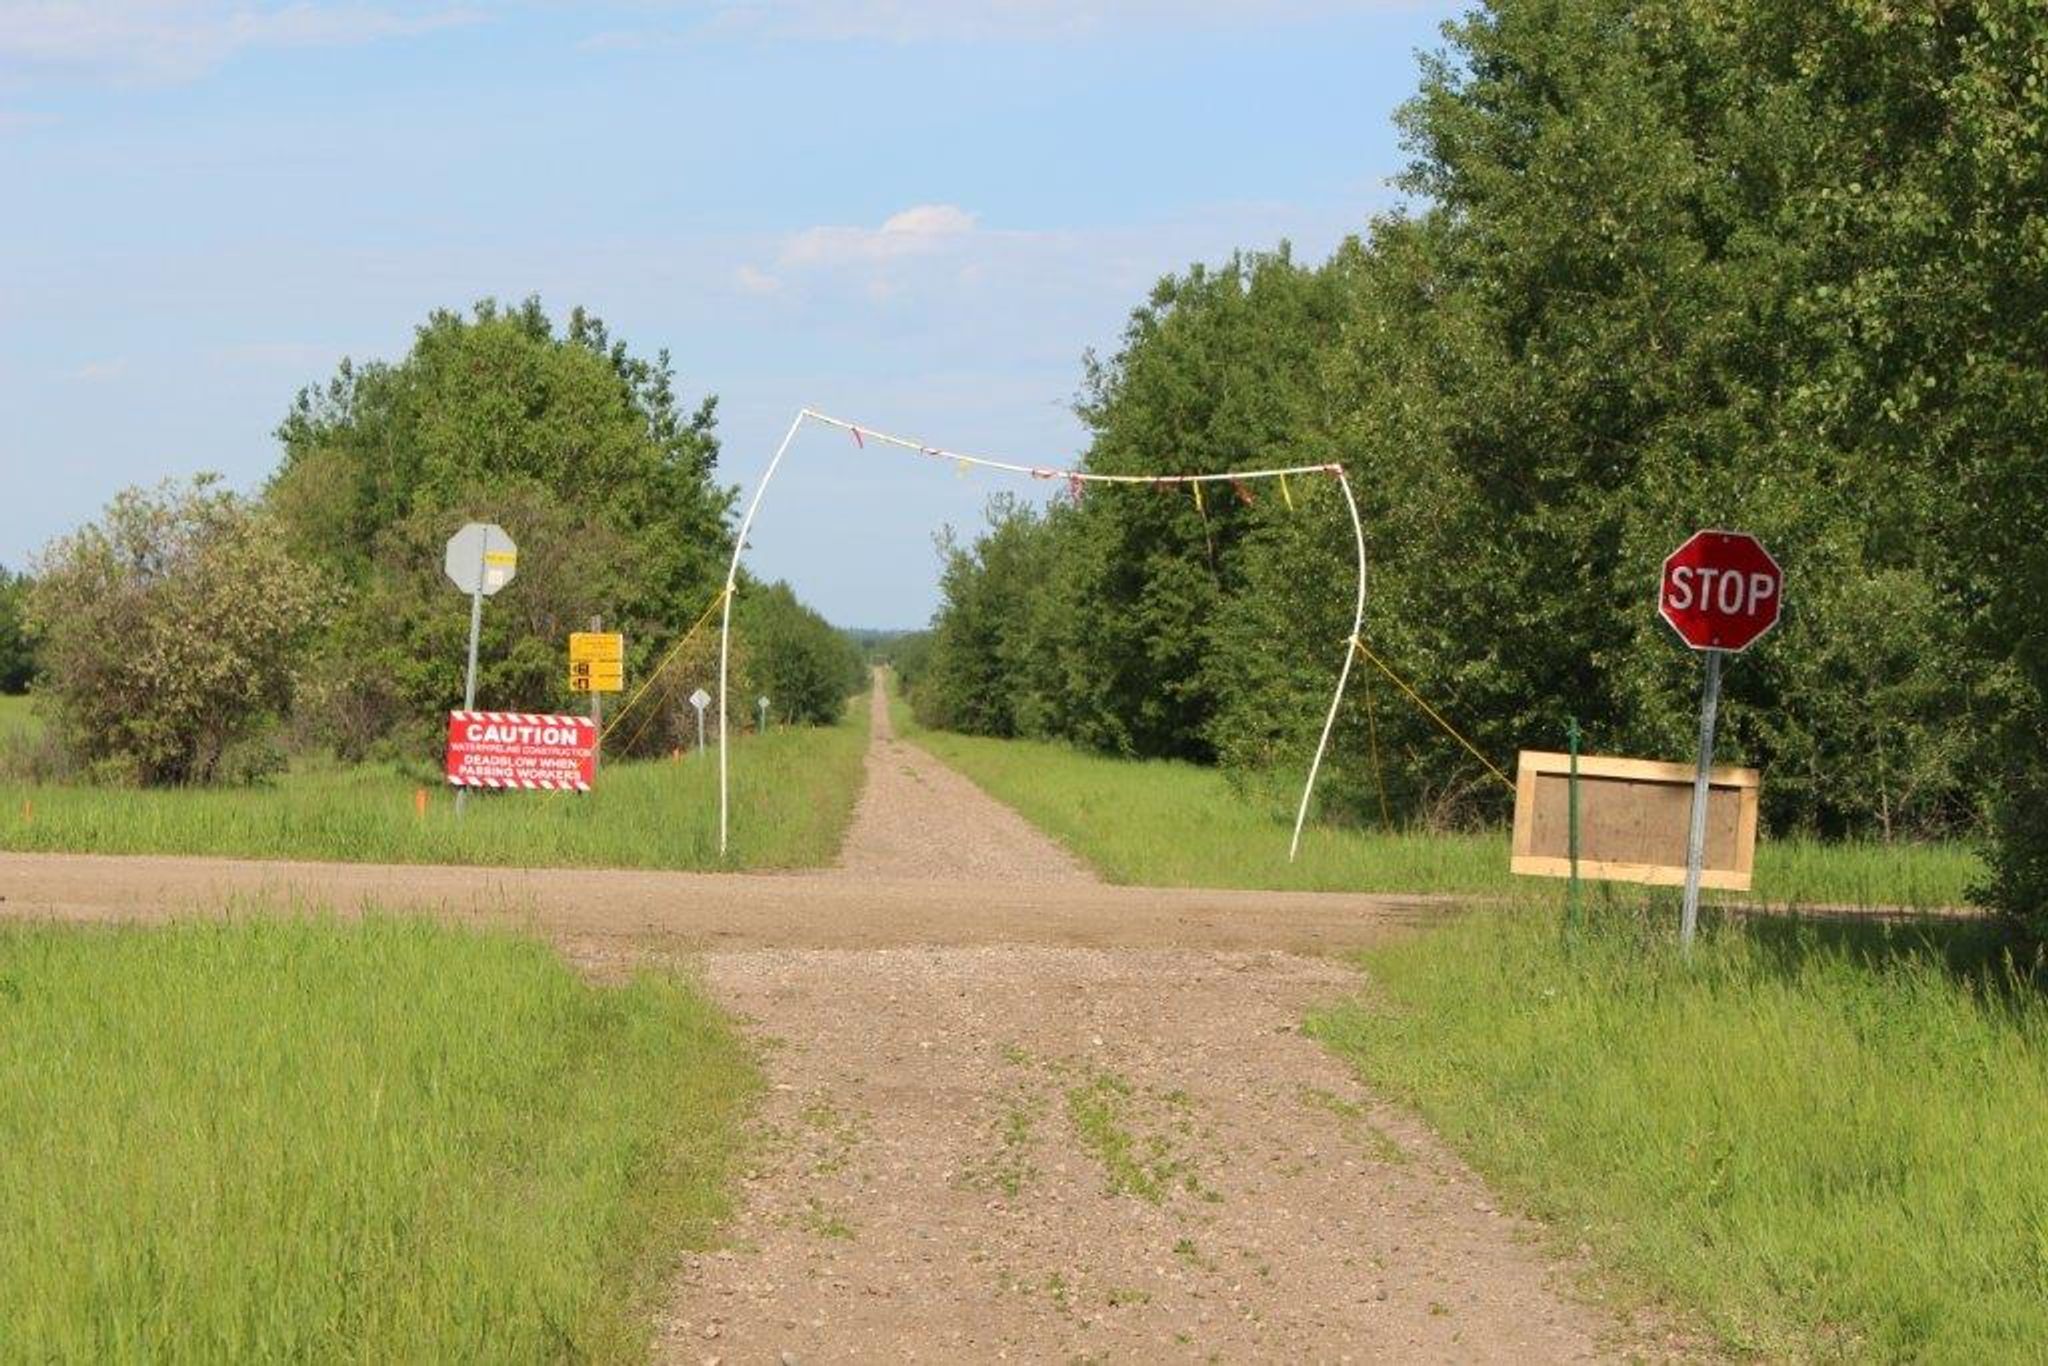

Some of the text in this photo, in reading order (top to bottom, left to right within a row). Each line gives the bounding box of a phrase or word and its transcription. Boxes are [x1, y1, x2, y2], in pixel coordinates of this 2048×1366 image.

[1668, 566, 1775, 615] STOP
[466, 724, 577, 745] CAUTION
[540, 758, 577, 769] WHEN
[458, 765, 581, 781] PASSING WORKERS
